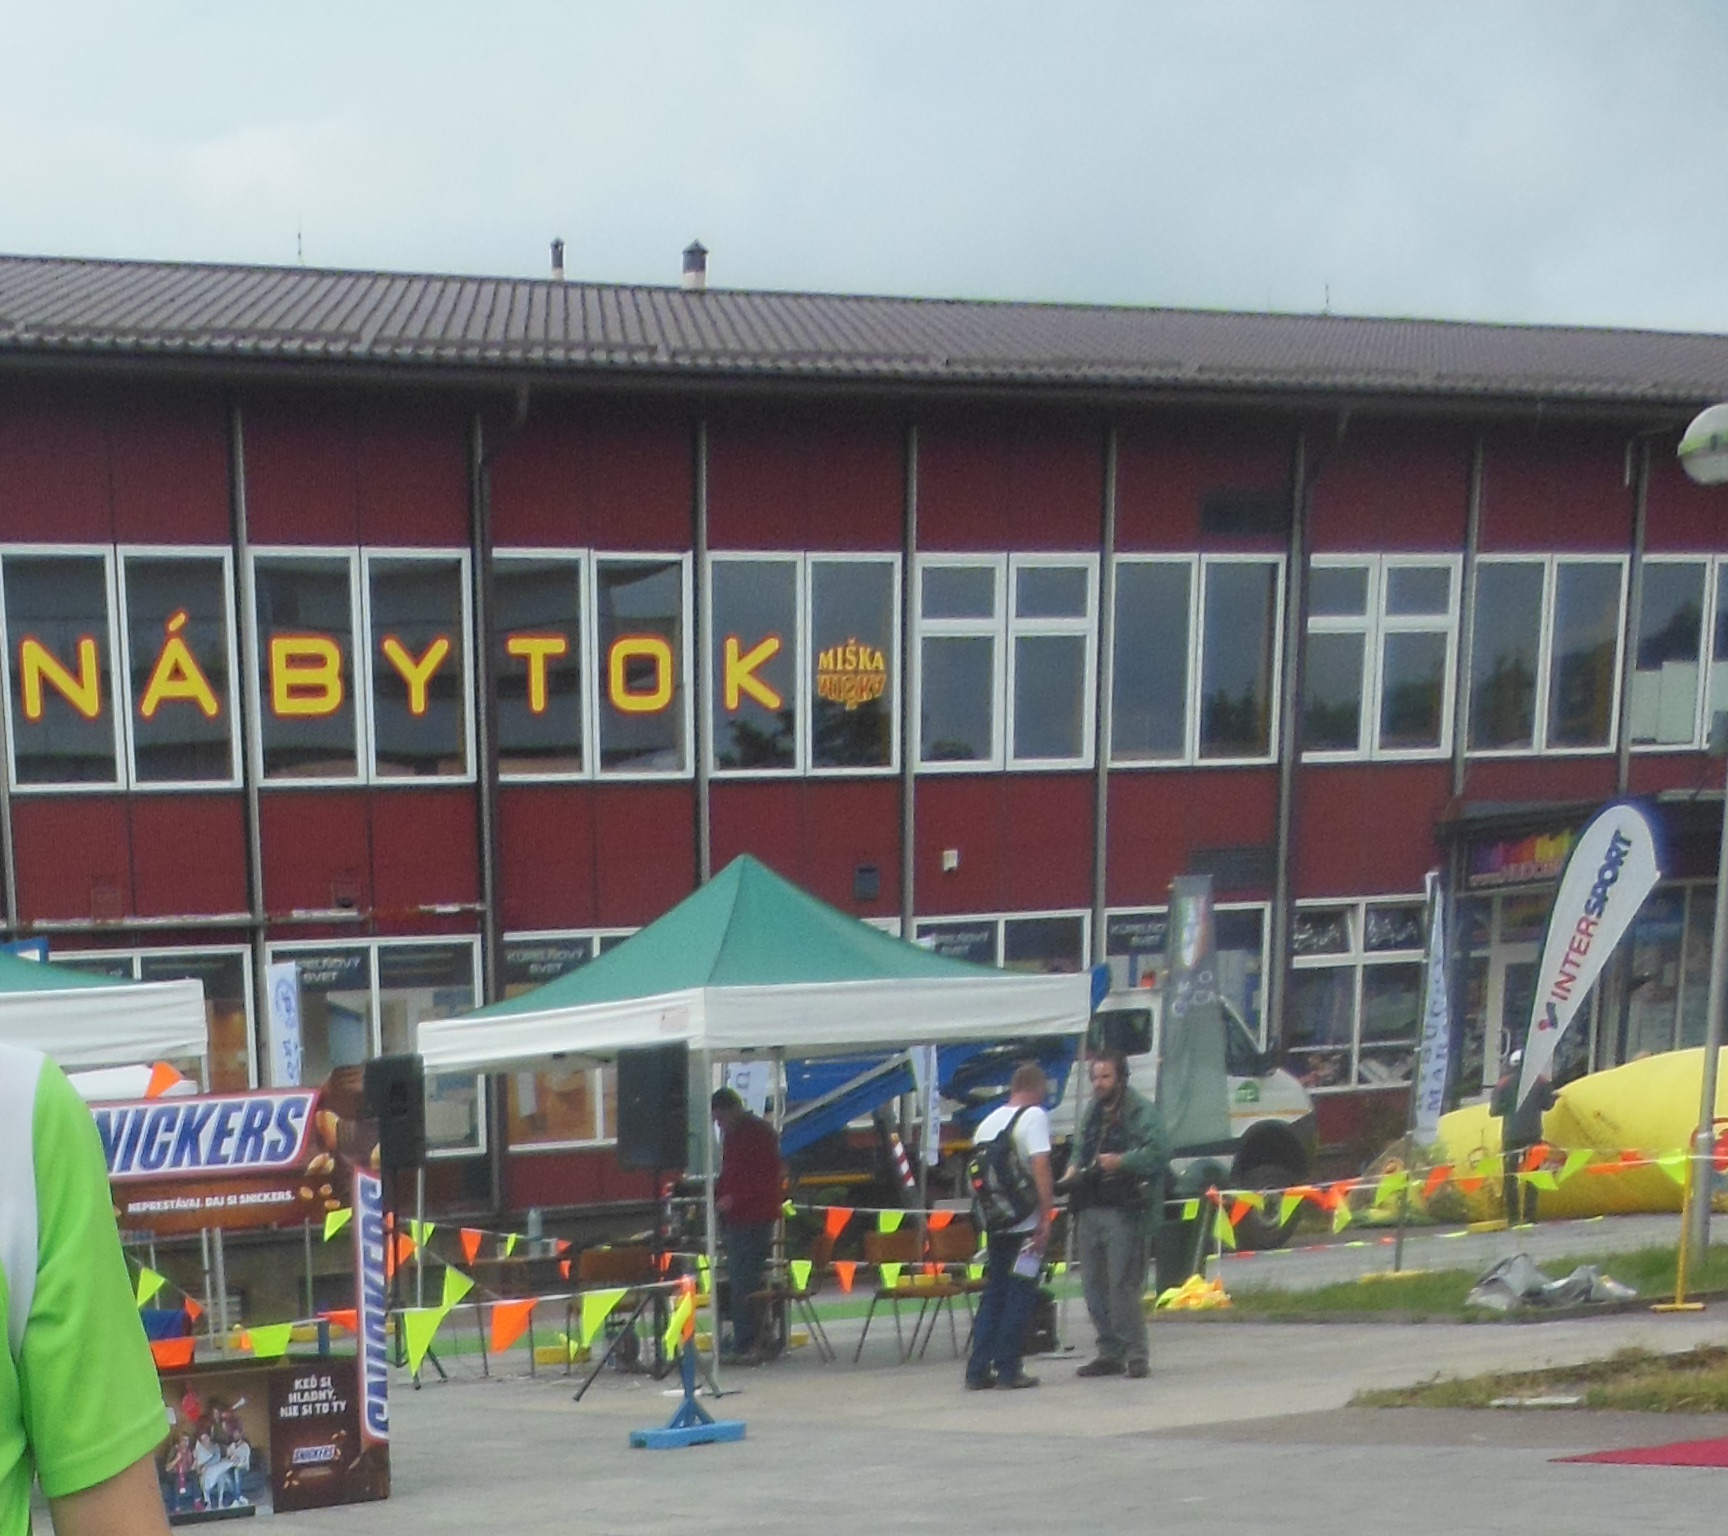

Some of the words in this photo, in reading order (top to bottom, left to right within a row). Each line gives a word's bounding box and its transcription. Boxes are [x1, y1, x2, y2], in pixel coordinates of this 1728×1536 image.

[19, 610, 782, 720] NÁBYTOK
[1550, 828, 1633, 1002] INTERSPORT
[94, 1096, 304, 1173] NICKERS
[205, 1196, 225, 1208] DAJ
[227, 1194, 237, 1206] SI
[320, 1376, 333, 1388] SI
[280, 1404, 300, 1418] NIE
[301, 1403, 313, 1416] SI
[315, 1402, 330, 1414] TO
[332, 1400, 347, 1413] TY
